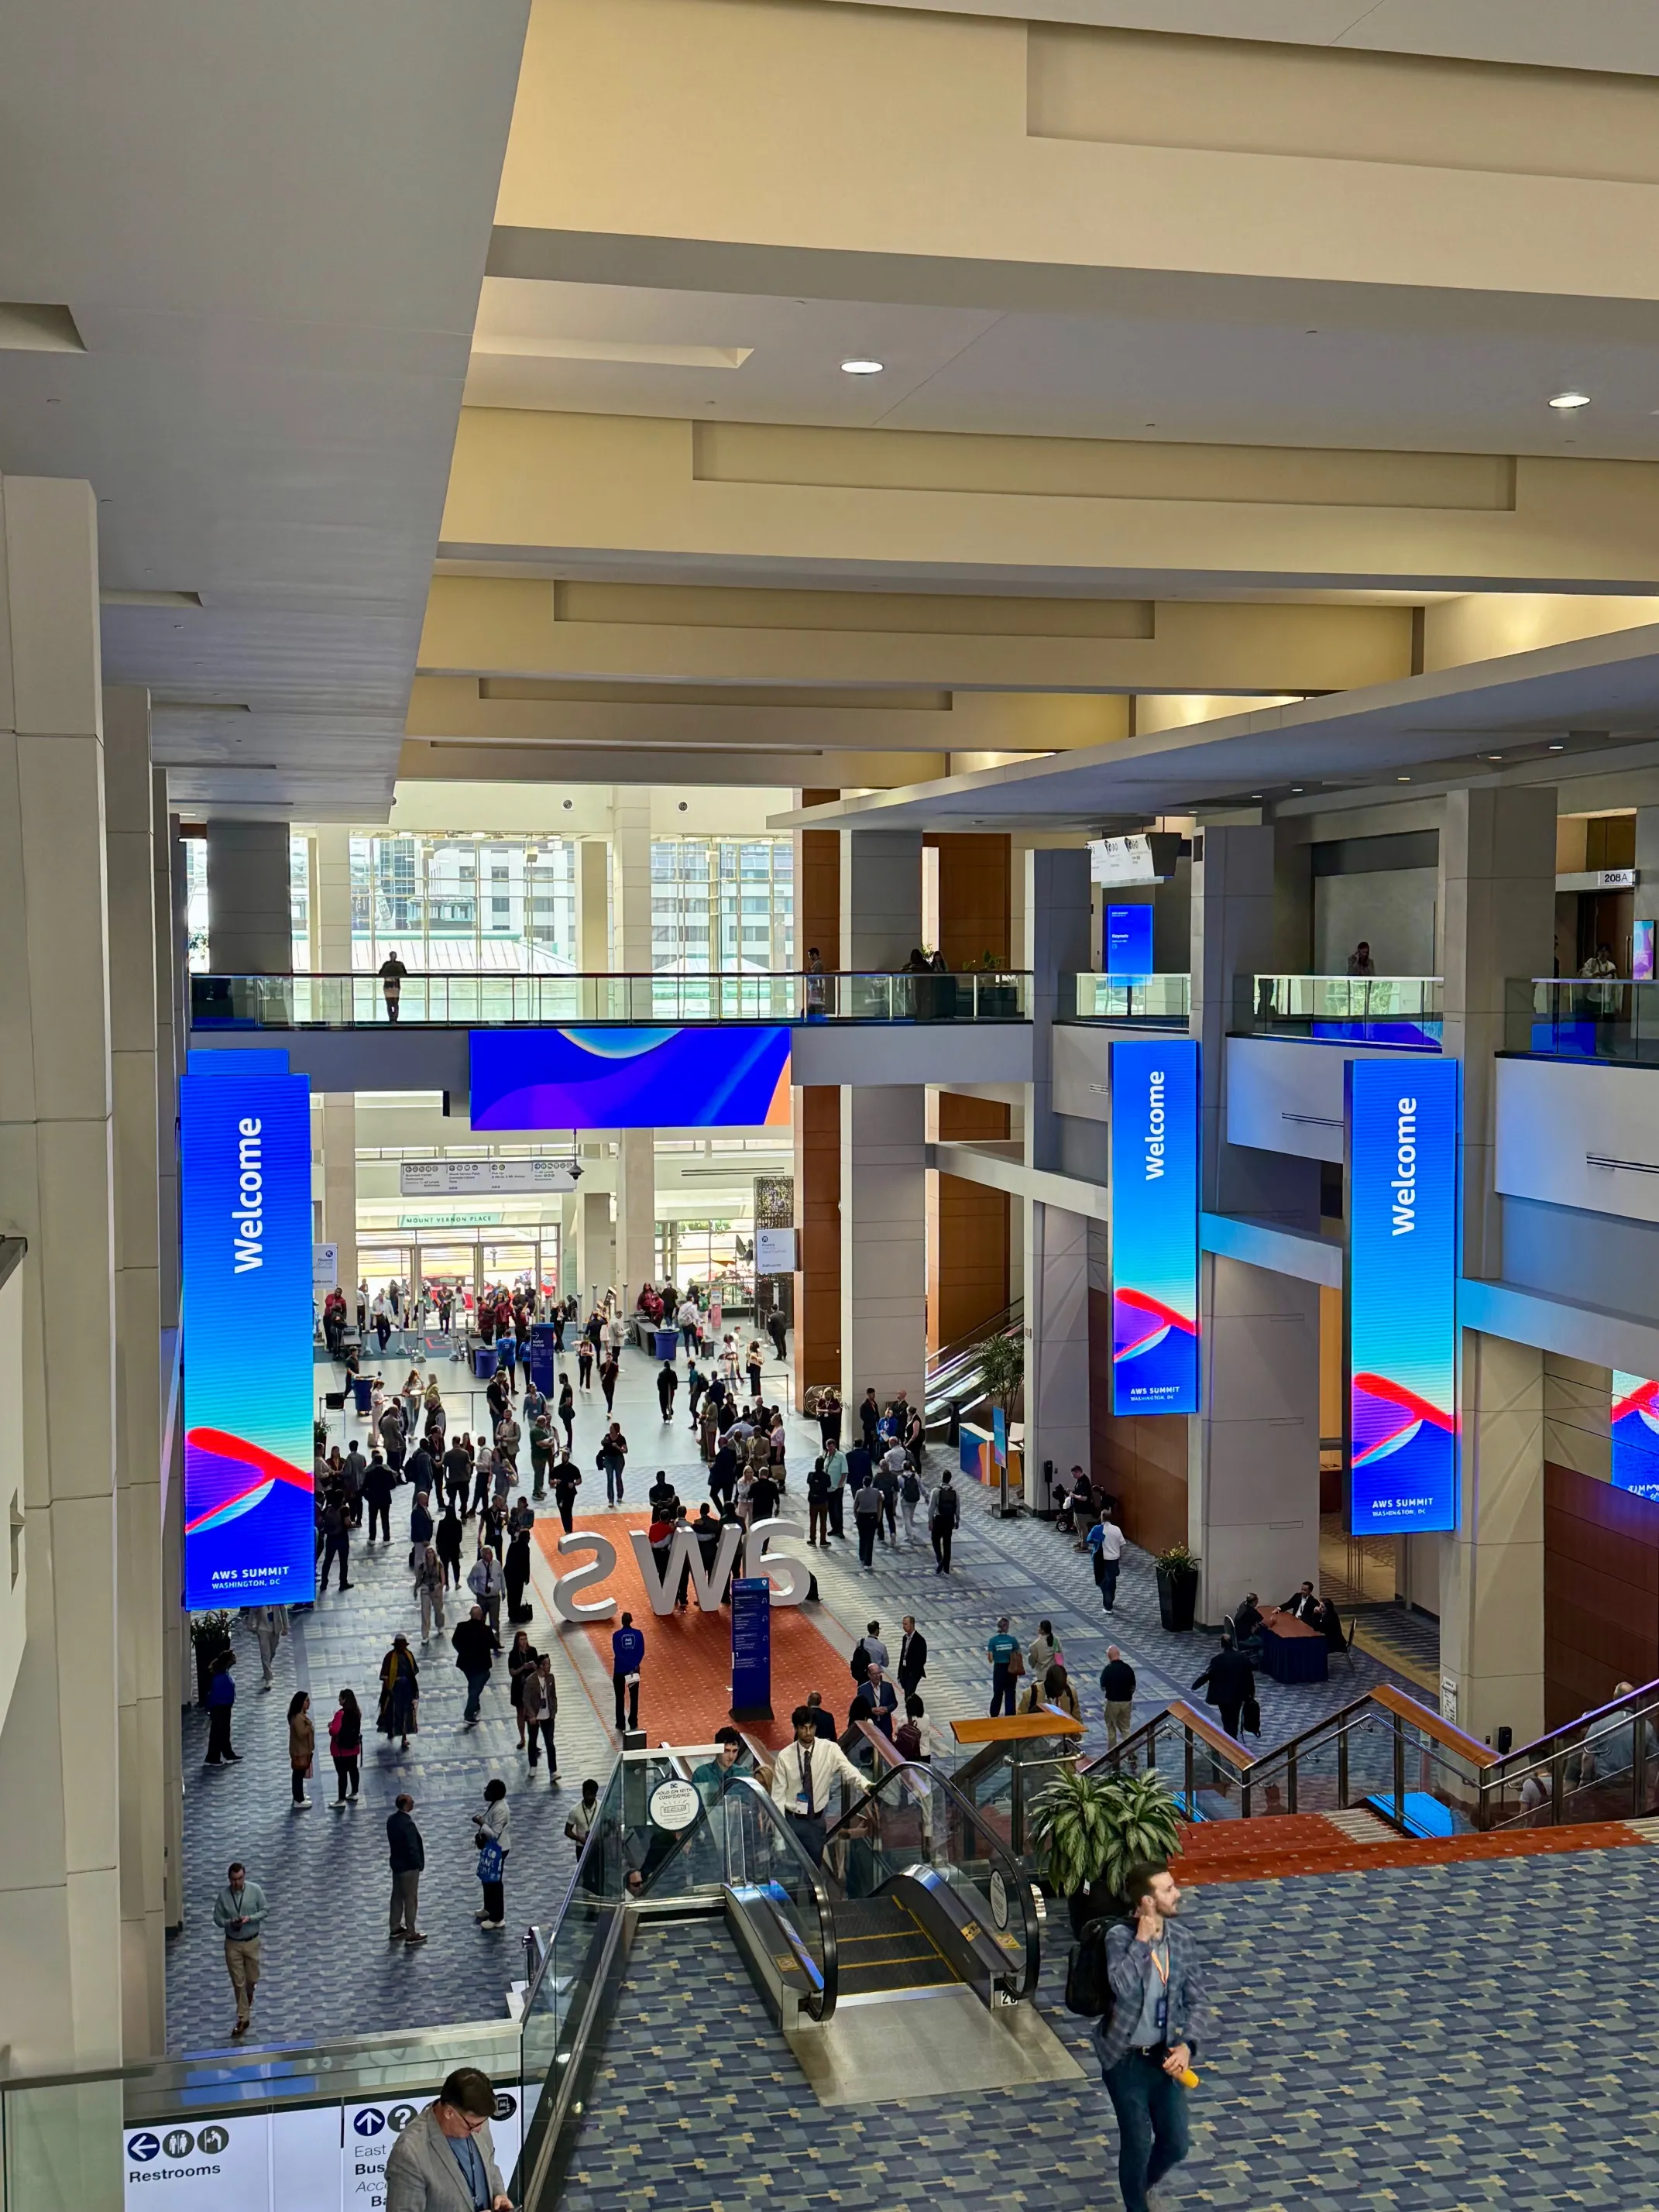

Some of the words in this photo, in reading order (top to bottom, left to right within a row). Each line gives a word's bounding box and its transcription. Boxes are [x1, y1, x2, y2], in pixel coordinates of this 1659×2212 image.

[1604, 873, 1629, 883] 208A
[1144, 1070, 1165, 1181] Welcome
[1391, 1097, 1417, 1236] Welcome
[232, 1118, 263, 1274] Welcome
[1372, 1499, 1393, 1509] AWS
[1396, 1497, 1434, 1507] SUMMIT
[211, 1570, 238, 1580] AWS
[242, 1566, 290, 1578] SUMMIT
[355, 2144, 387, 2158] East
[129, 2165, 222, 2183] Restrooms
[355, 2163, 386, 2176] Bus
